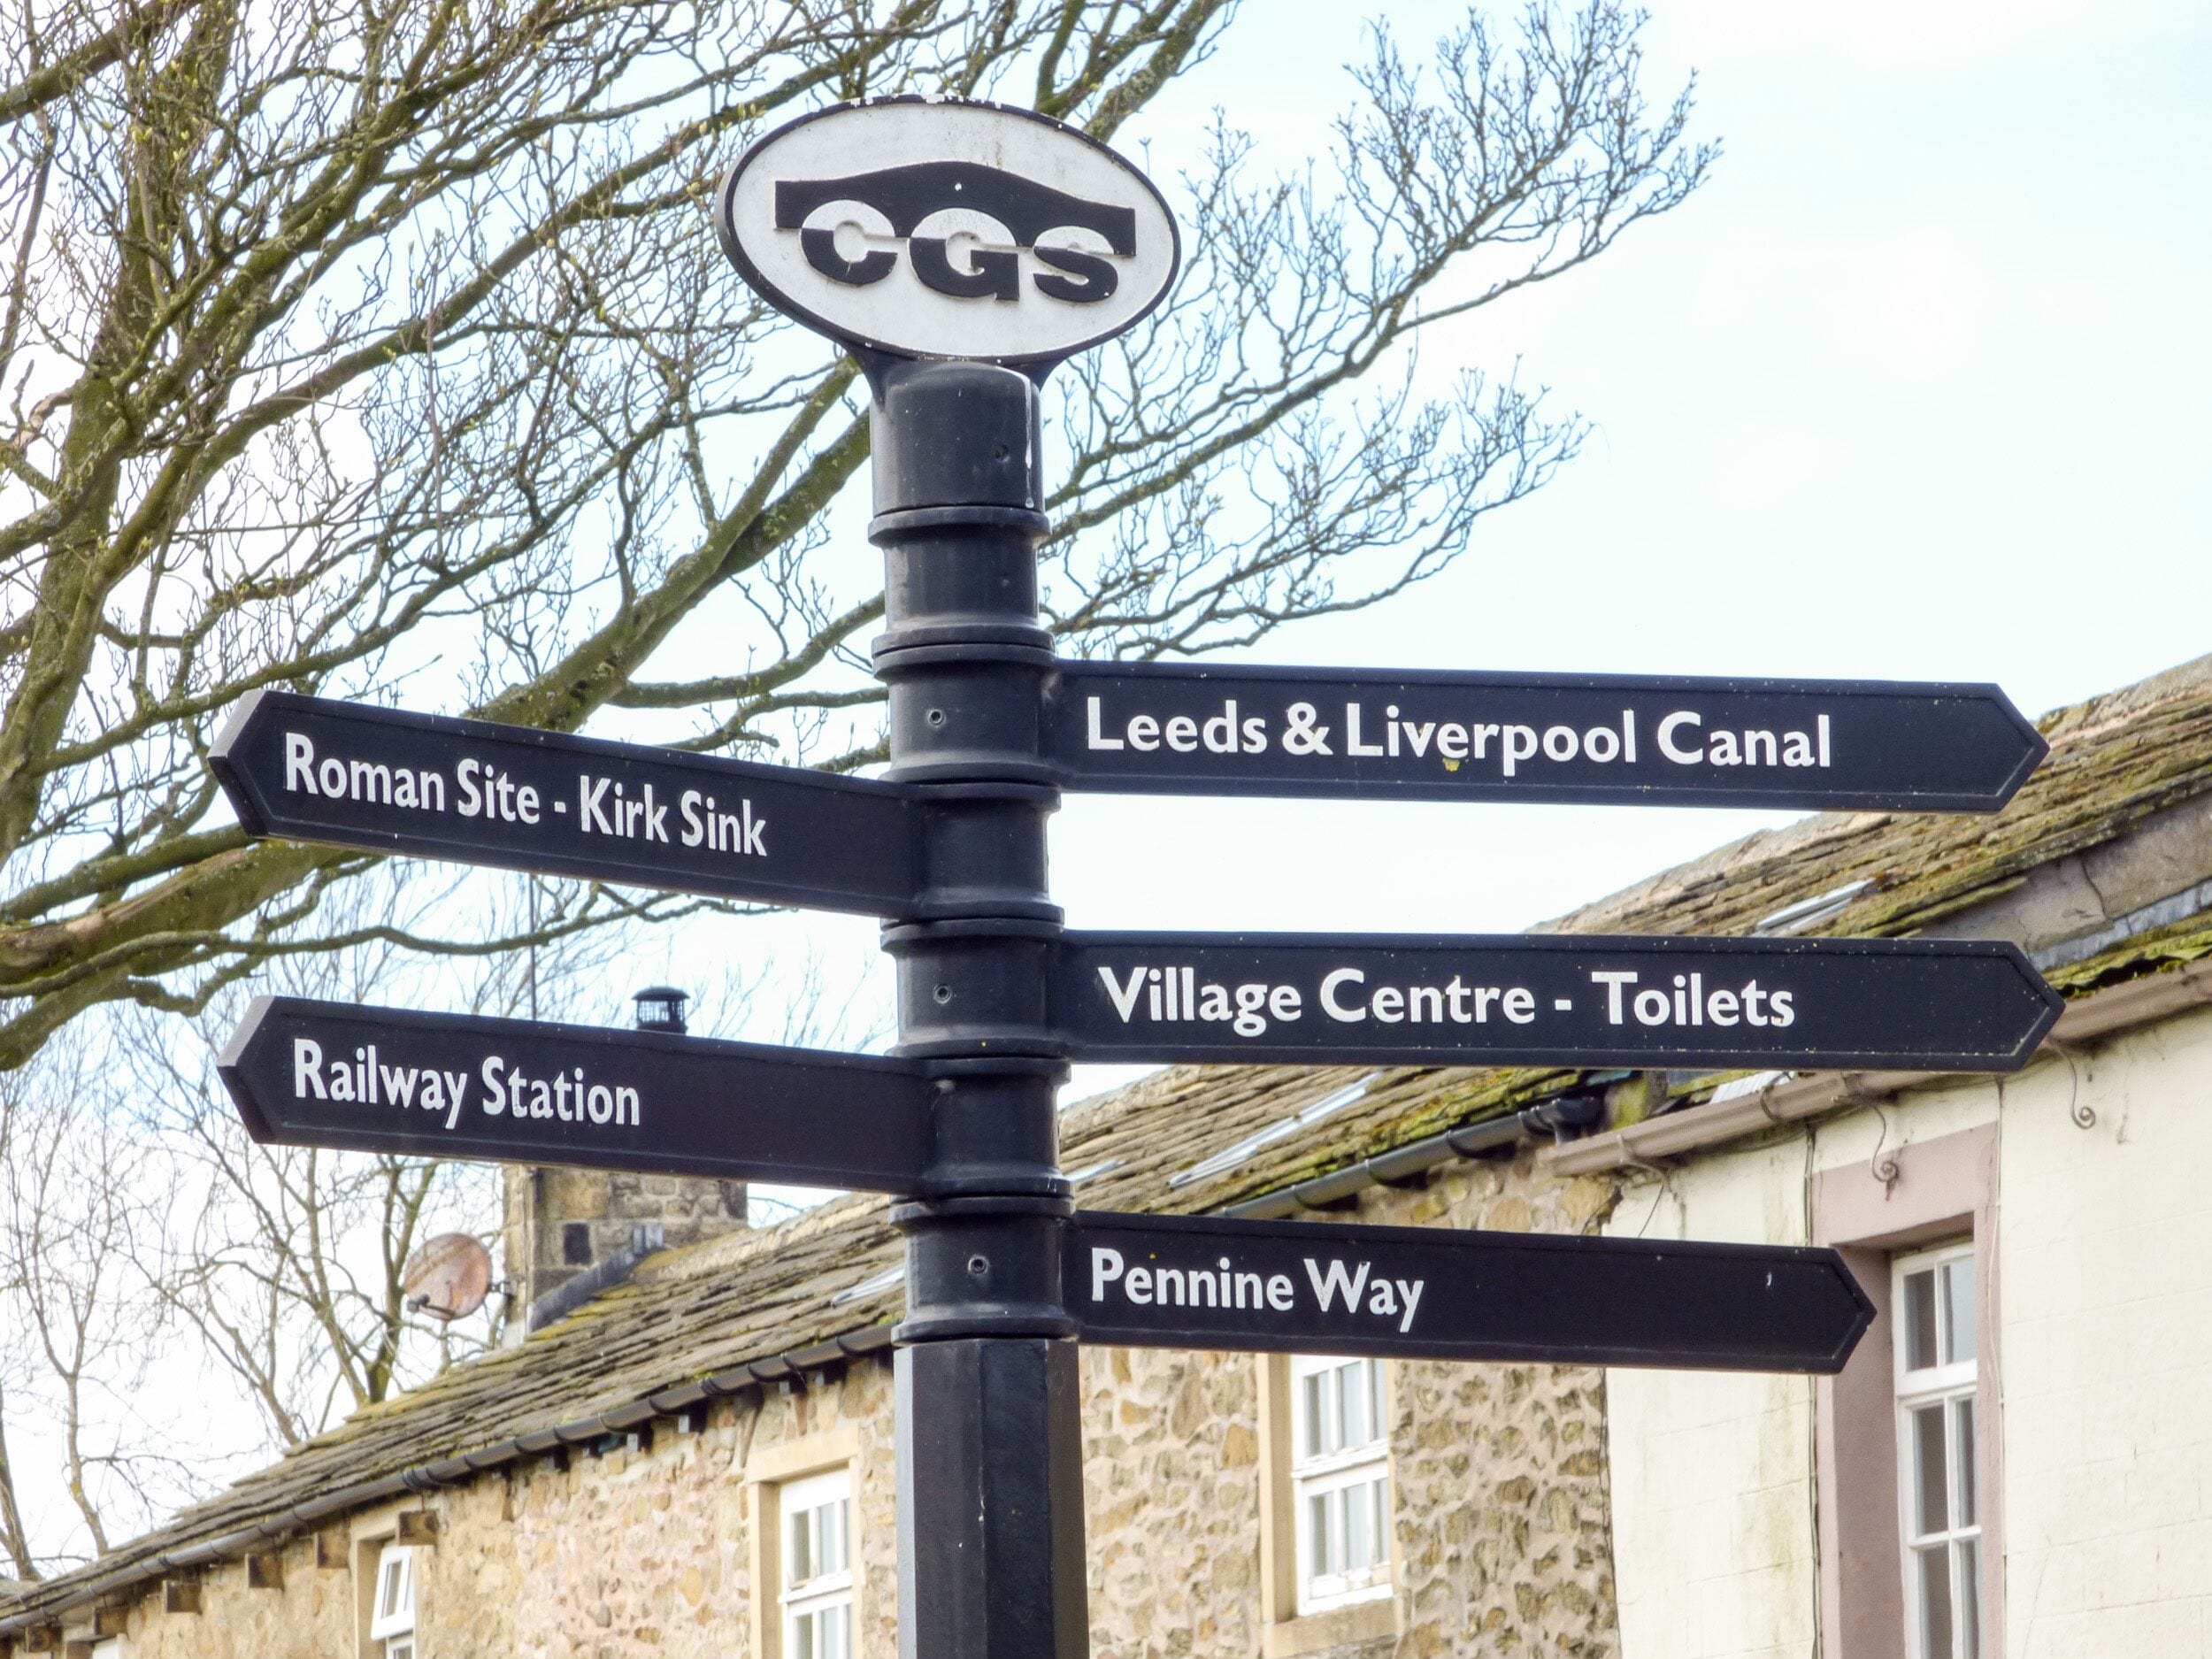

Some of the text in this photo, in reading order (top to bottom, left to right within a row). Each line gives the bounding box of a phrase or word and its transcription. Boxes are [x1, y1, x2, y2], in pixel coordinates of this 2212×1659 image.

[799, 198, 1119, 304] CGS
[1087, 696, 1831, 777] Leeds & Liverpool Canal
[286, 732, 767, 856] Roman Site - Kirk Sink
[1097, 966, 1795, 1037] Village Centre - Toilets
[294, 1038, 641, 1130] Railway Station
[1092, 1247, 1425, 1333] Pennine Way
